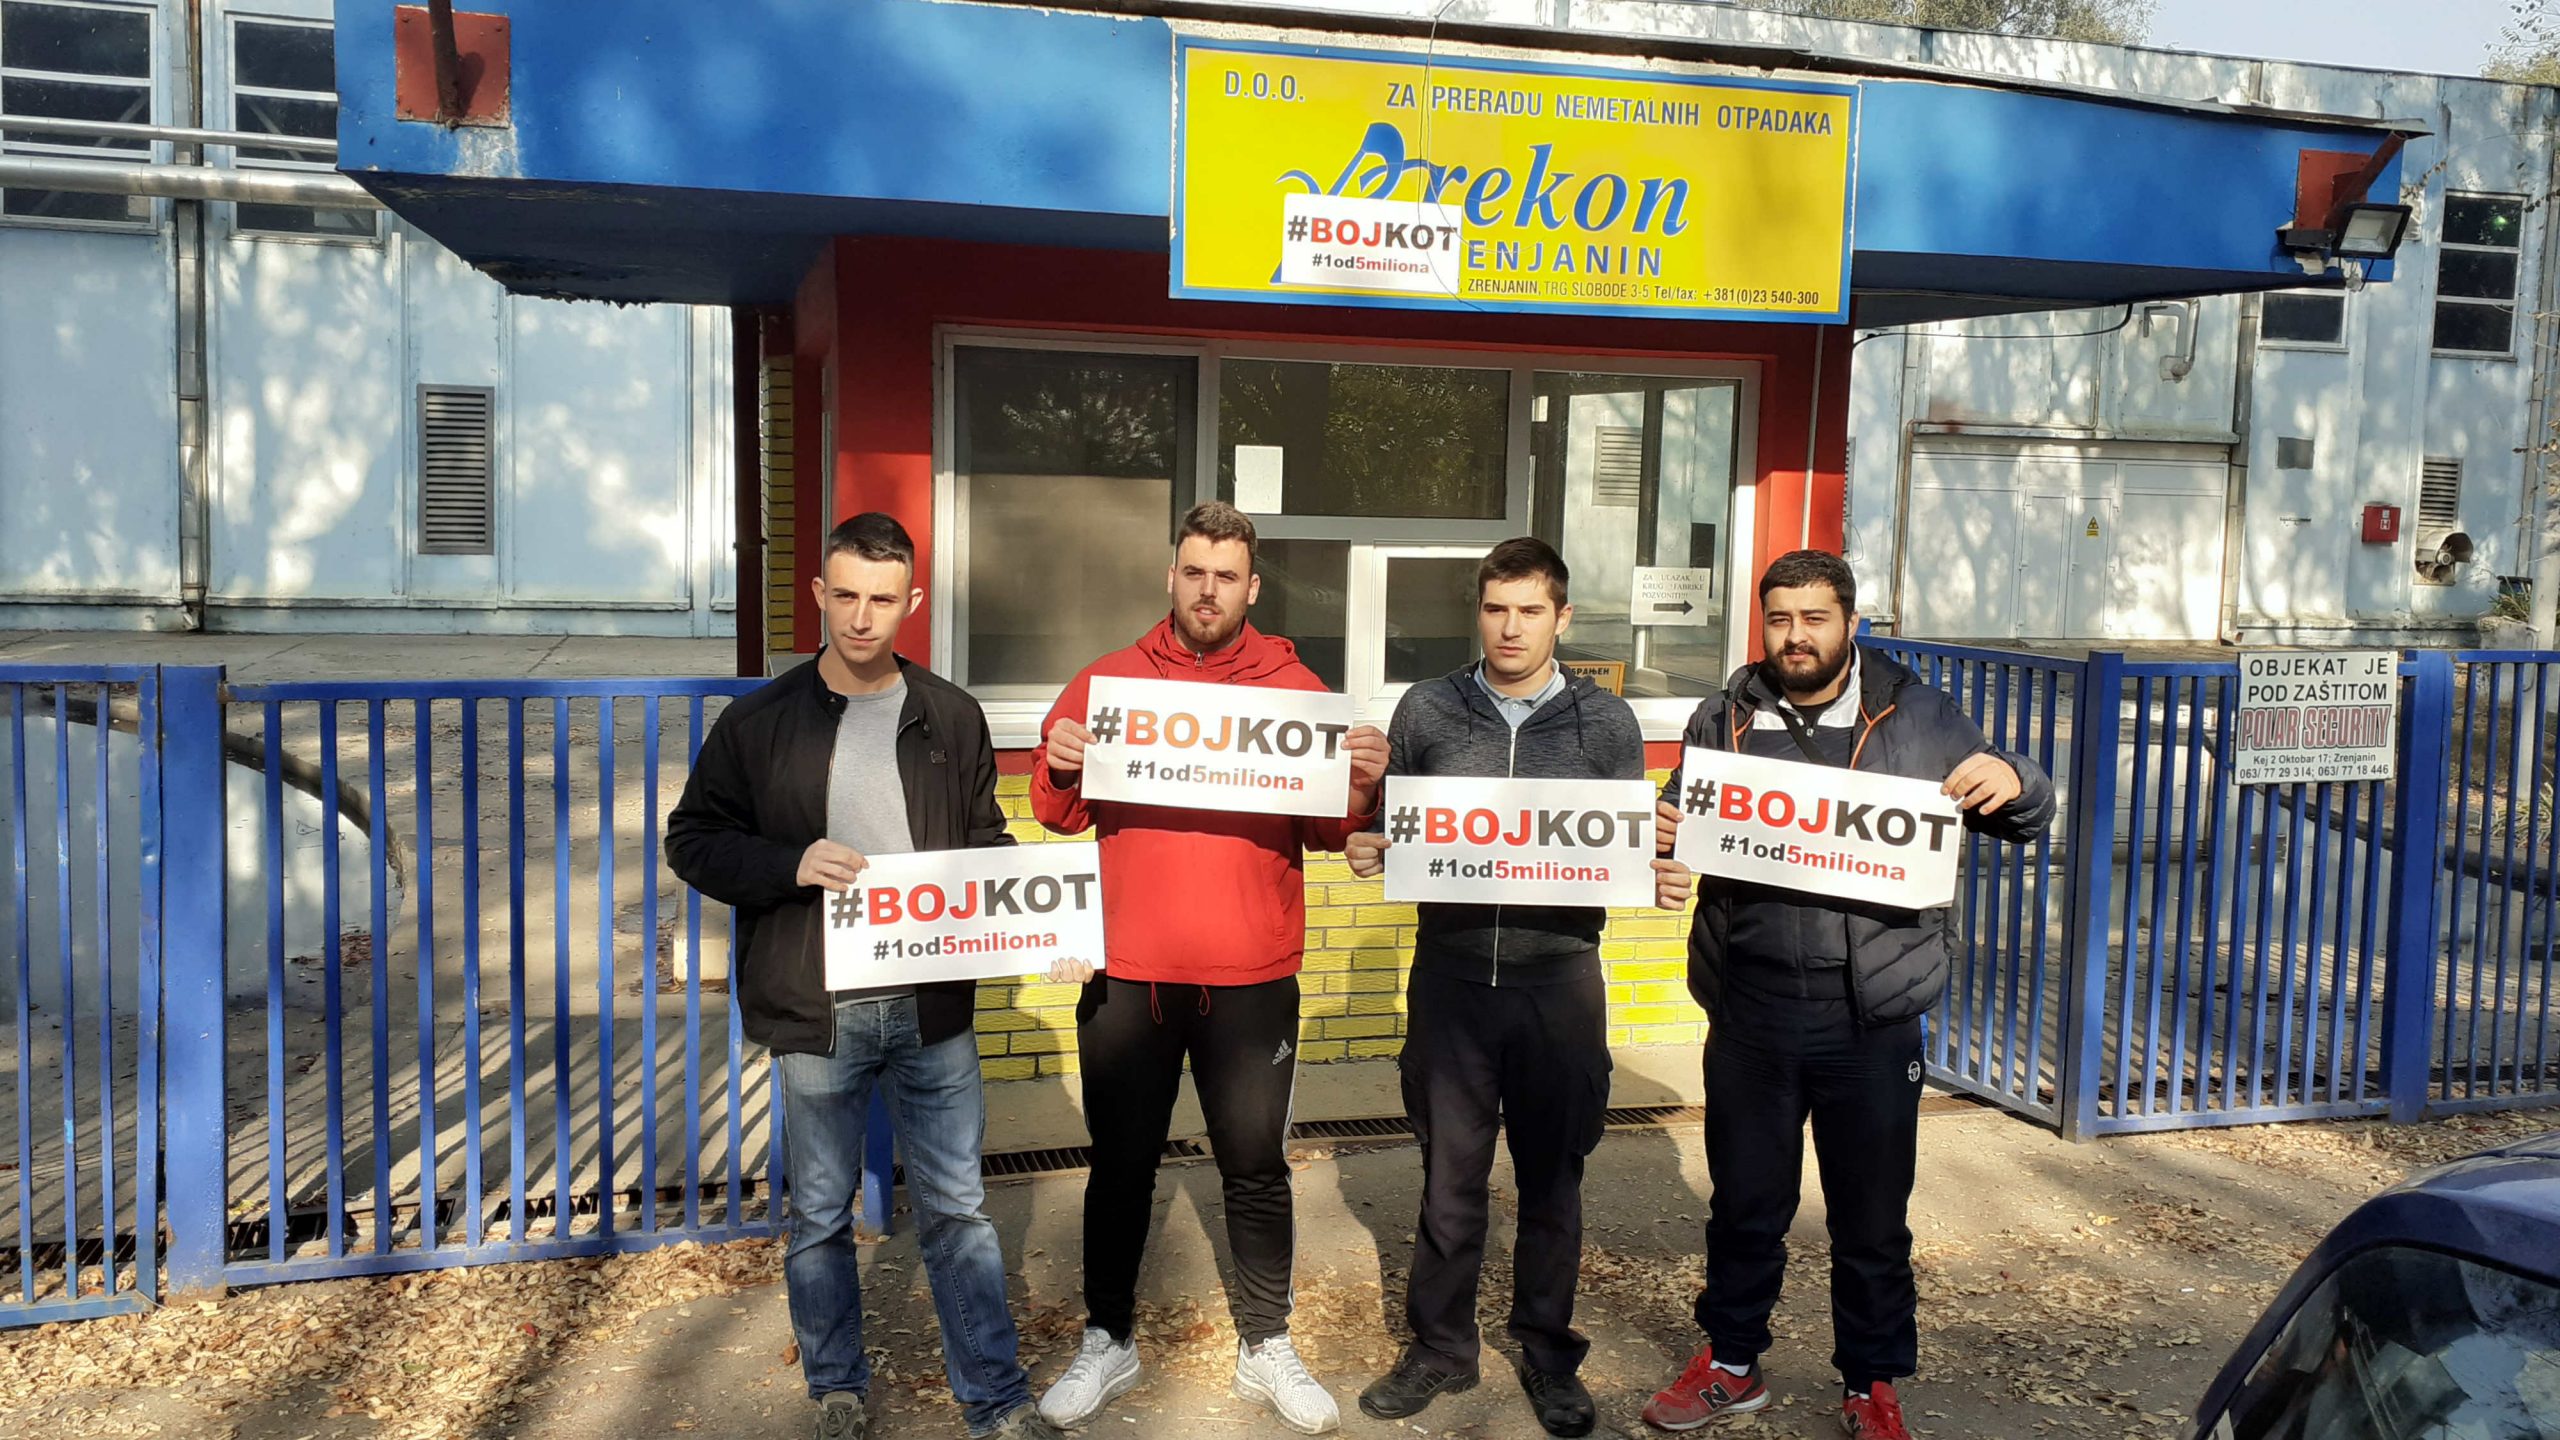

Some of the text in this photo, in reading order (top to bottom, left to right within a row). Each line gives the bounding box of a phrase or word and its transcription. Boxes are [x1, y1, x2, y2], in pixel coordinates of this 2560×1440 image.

[1224, 69, 1305, 102] D.O.O.
[1386, 82, 1832, 135] ZA PRERADU NEMETALNIH OTPADAKA
[1287, 215, 1458, 251] #BOJKOT
[1312, 252, 1430, 274] #1od5miliona
[1467, 239, 1662, 277] ENJANIN
[1467, 278, 1541, 296] ZRENJANIN,
[1544, 280, 1568, 295] TRG
[1571, 281, 1628, 298] SLOBODE
[1631, 284, 1649, 298] 3-5
[1654, 285, 1698, 301] Tel/fax:
[1703, 287, 1768, 305] +381(0)23
[1771, 290, 1820, 305] 540-300
[2249, 657, 2389, 677] OBJEKAT JE
[2248, 679, 2387, 703] POD ZAŠTITOM
[1092, 706, 1350, 760] #BOJKOT
[2239, 704, 2392, 750] POLAR SECURITY
[1126, 760, 1304, 791] #1od5miliona
[2239, 768, 2261, 779] 063/
[2264, 767, 2275, 778] 77
[2278, 767, 2291, 778] 29
[2317, 766, 2340, 777] 063/
[2342, 765, 2353, 776] 77
[2356, 765, 2368, 776] 18
[2370, 764, 2389, 775] 446
[2253, 753, 2376, 767] Kej 2 Oktobar 17; Zrenjanin
[1390, 806, 1652, 848] #BOJKOT
[1685, 778, 1957, 852] #BOJKOT
[1428, 858, 1610, 882] #1od5miliona
[1719, 833, 1906, 882] #1od5miliona
[831, 873, 1097, 929] #BOJKOT
[873, 931, 1059, 961] #1od5miliona
